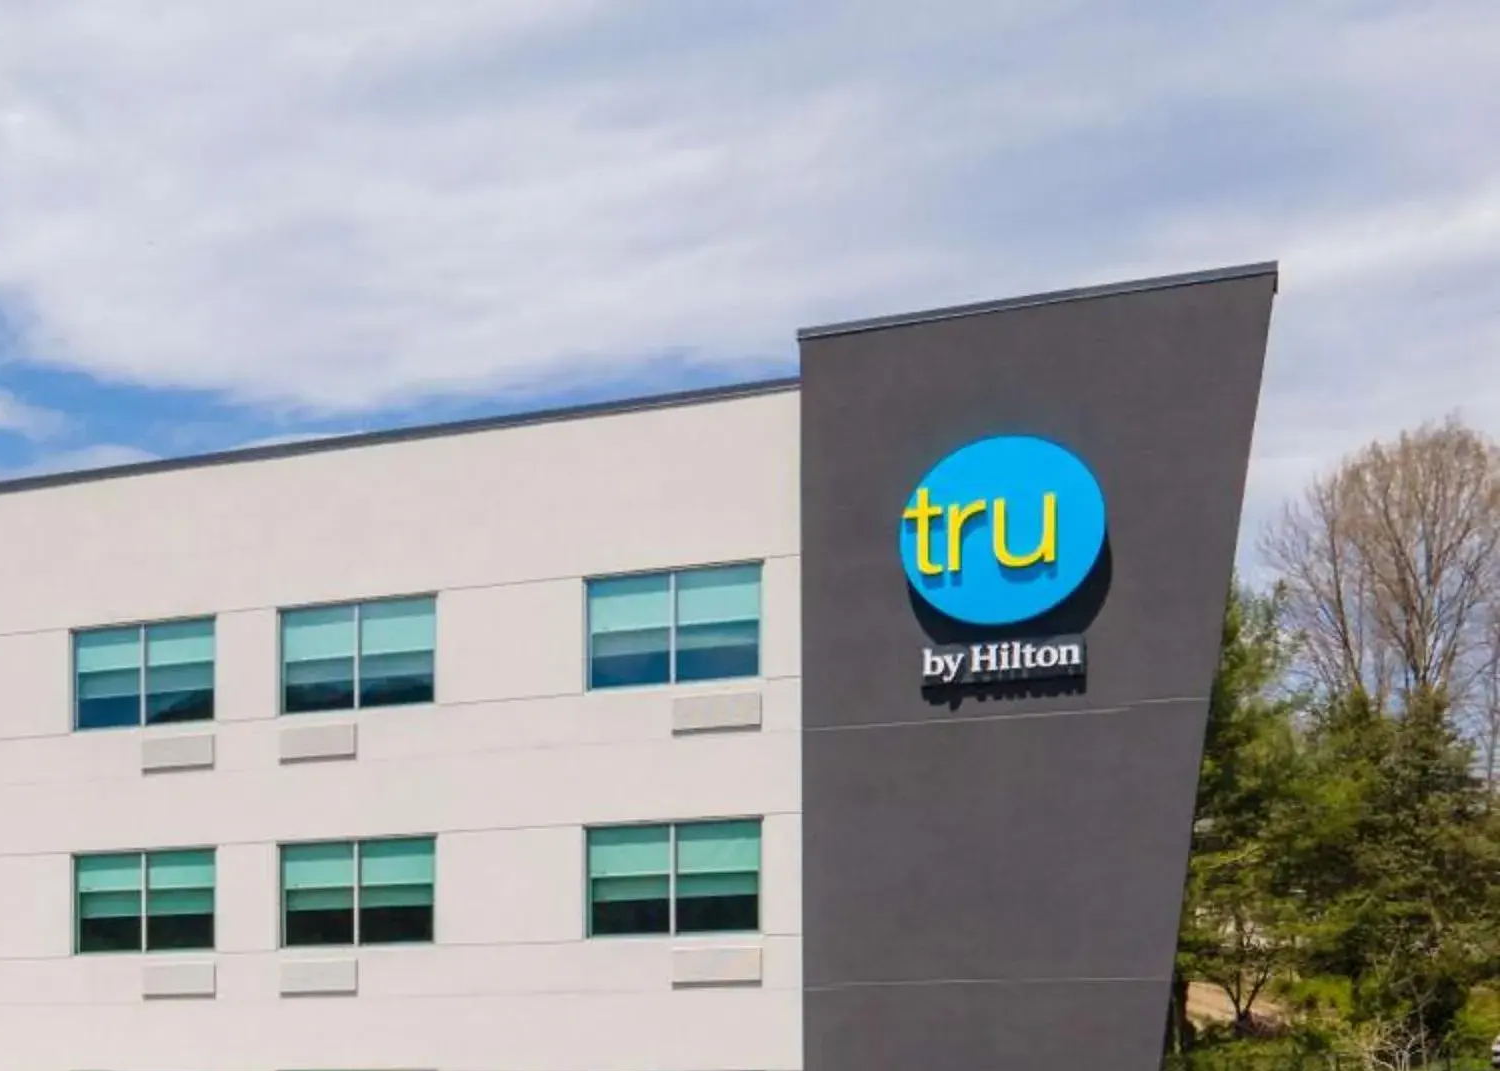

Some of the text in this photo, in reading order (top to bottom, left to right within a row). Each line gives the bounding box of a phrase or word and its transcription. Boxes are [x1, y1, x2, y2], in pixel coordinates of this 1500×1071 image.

[903, 487, 1057, 575] tru
[922, 639, 1082, 682] by Hilton
